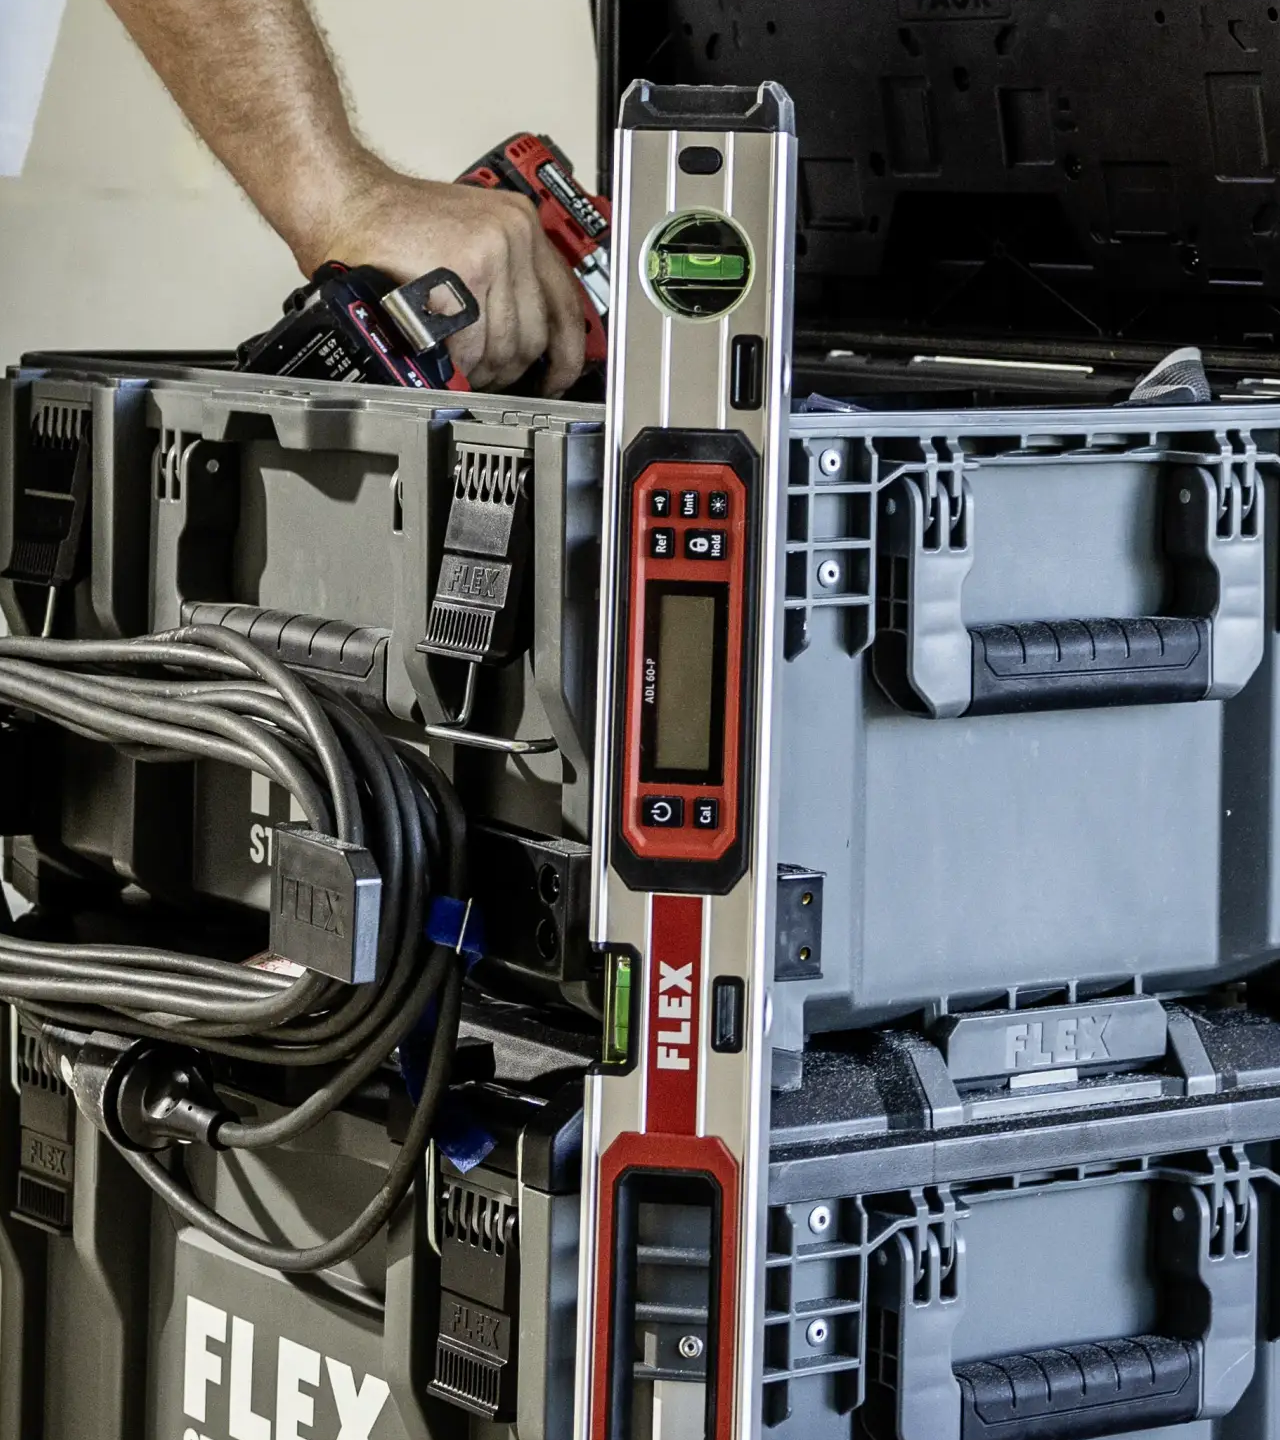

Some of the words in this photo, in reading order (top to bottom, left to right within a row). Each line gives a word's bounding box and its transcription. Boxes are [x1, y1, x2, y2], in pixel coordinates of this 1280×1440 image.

[684, 493, 695, 515] Unit
[655, 533, 667, 553] Ref
[711, 534, 721, 557] Hold
[448, 563, 500, 598] FLEX
[646, 658, 657, 682] 60-P
[645, 680, 656, 704] ADL
[699, 806, 712, 824] Cal
[280, 874, 345, 938] FLEX
[656, 960, 693, 1071] FLEX
[1005, 1013, 1113, 1069] FLEX
[31, 1139, 67, 1175] FLEX
[451, 1302, 500, 1351] FLEX
